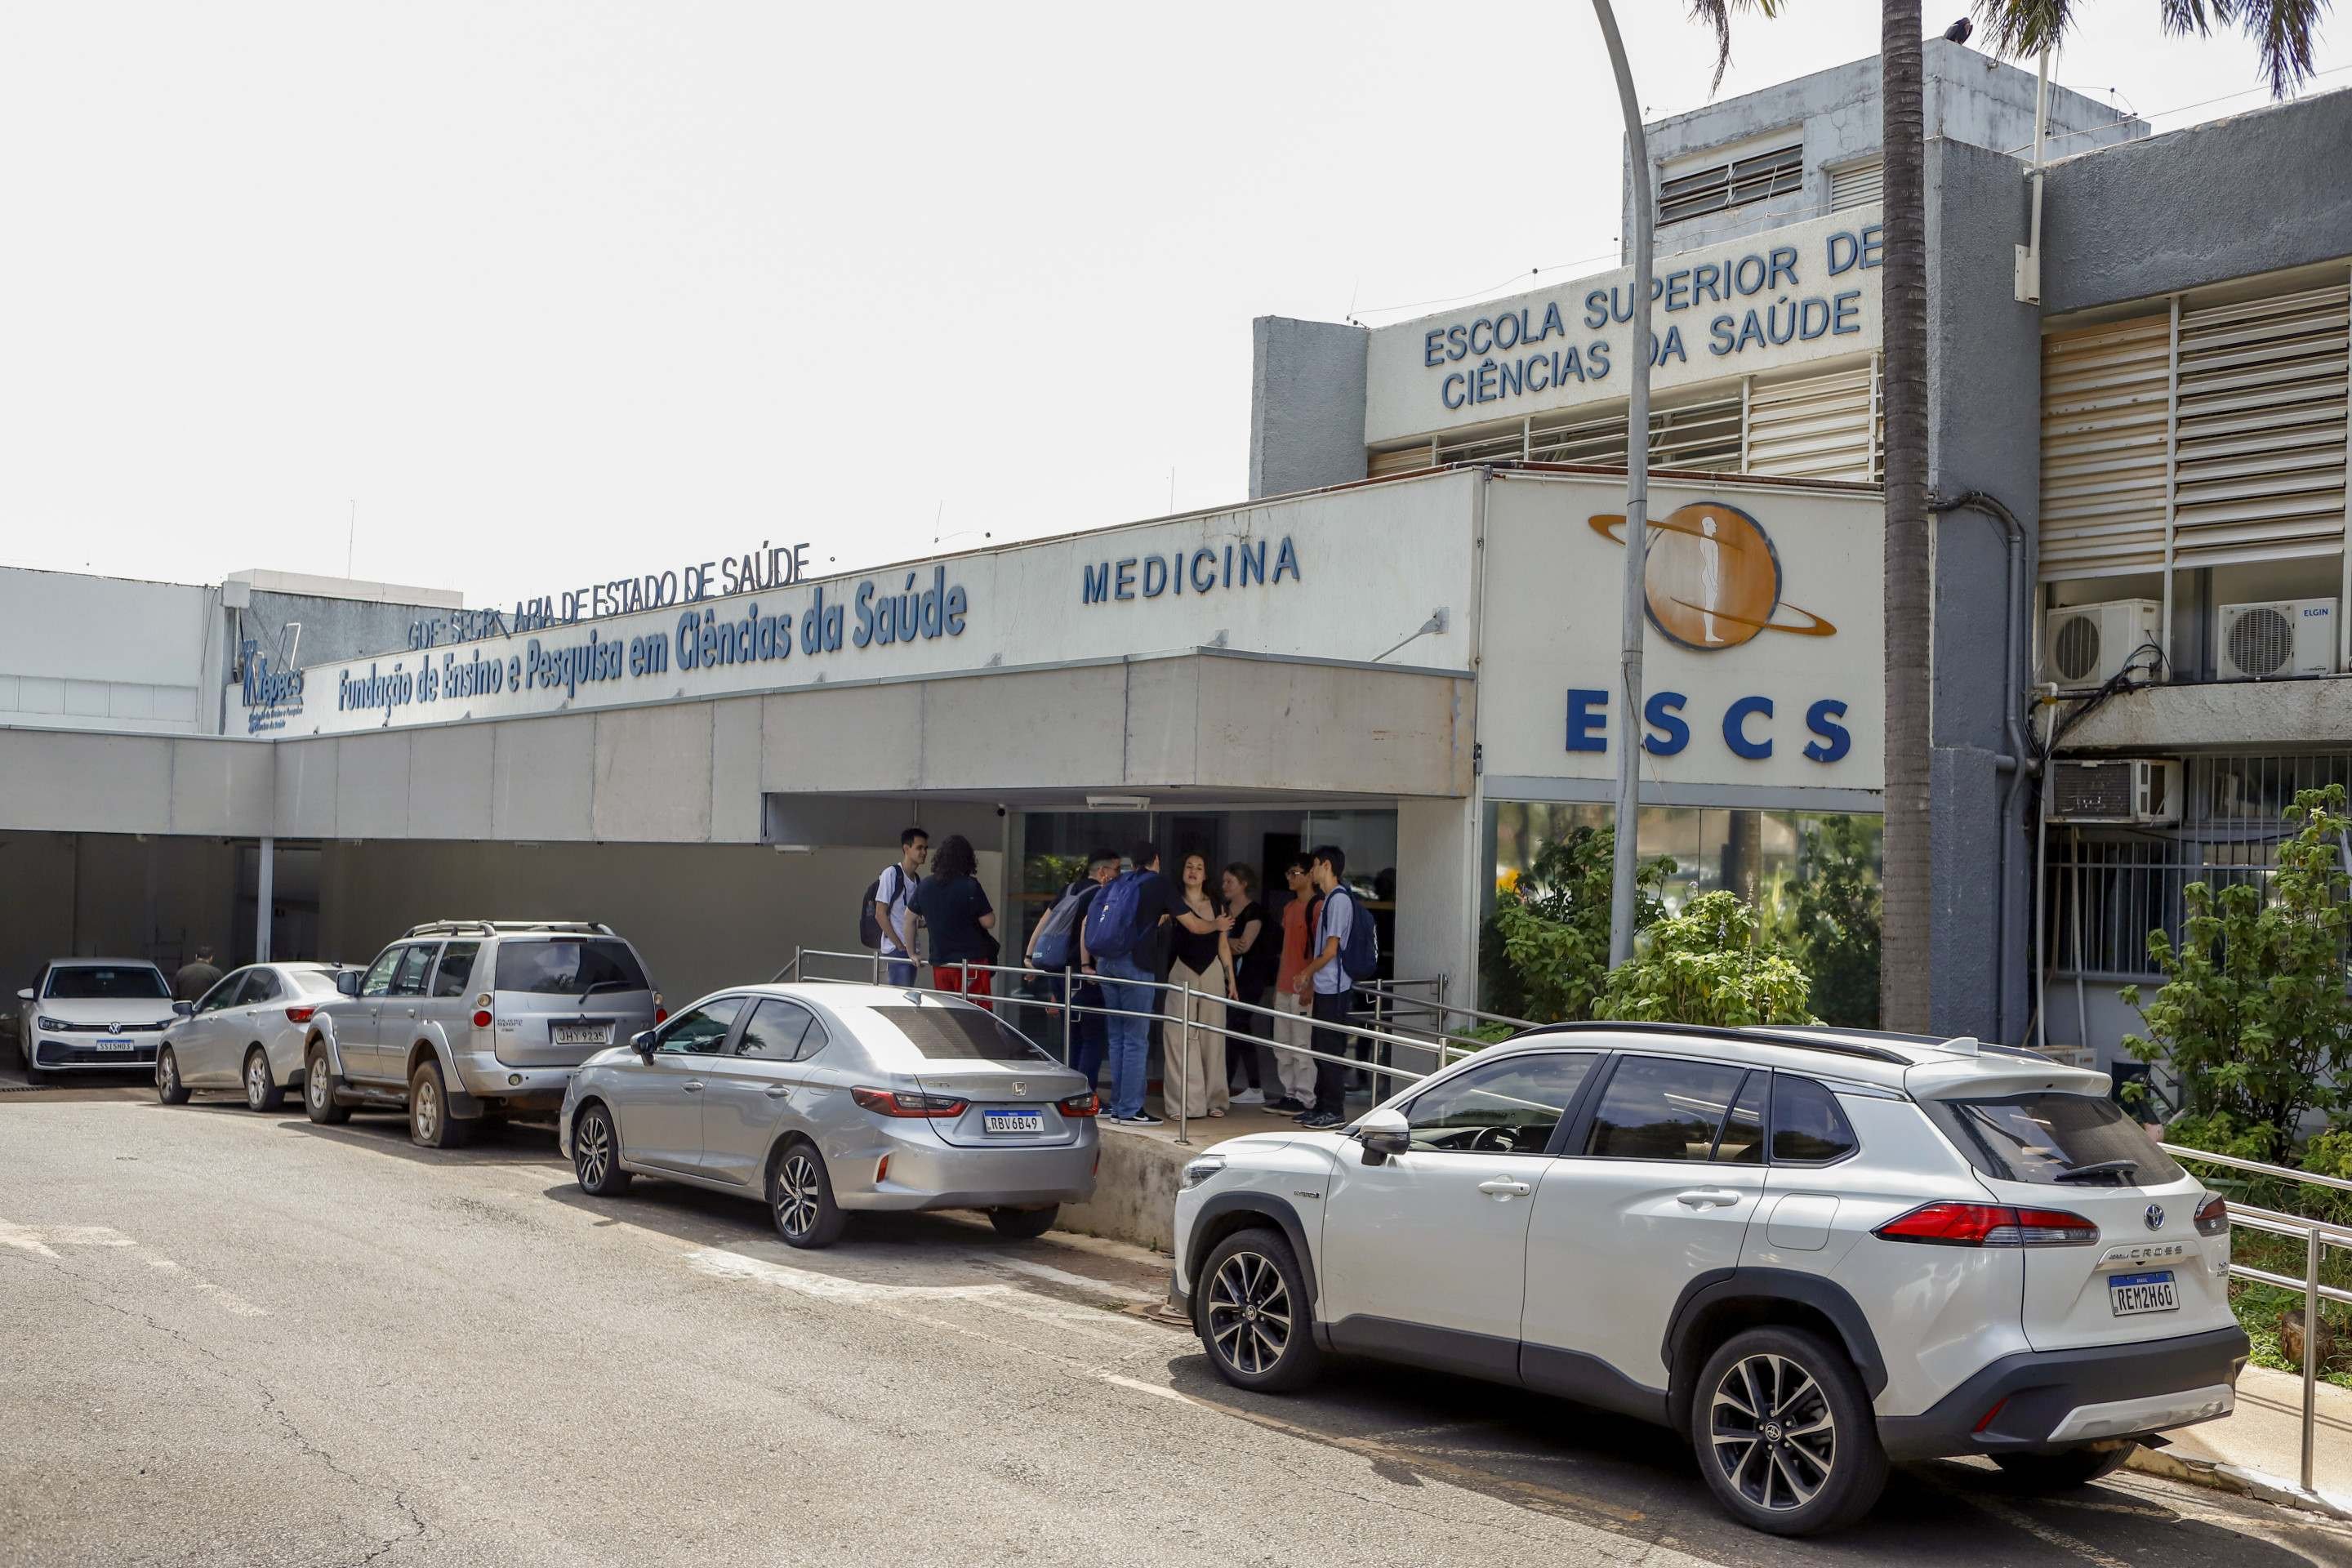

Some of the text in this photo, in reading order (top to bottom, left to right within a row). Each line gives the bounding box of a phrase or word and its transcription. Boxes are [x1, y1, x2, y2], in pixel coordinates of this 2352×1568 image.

[1424, 301, 1566, 368] ESCOLA
[1826, 224, 1882, 276] DE
[1441, 341, 1610, 409] CIÊNCIAS
[1708, 289, 1860, 355] SAÚDE
[561, 588, 589, 621] DE
[593, 571, 677, 617] ESTADO
[684, 562, 716, 604] DE
[722, 541, 810, 596] SAÚDE
[1082, 536, 1301, 605] MEDICINA
[338, 565, 968, 717] Fundação de Ensino e Pesquisa em Ciências da Saúde
[2304, 608, 2328, 617] ELGIN
[991, 1117, 1037, 1129] RBV6B49
[2131, 1246, 2183, 1258] CROSS
[2118, 1284, 2173, 1311] REM2H60
